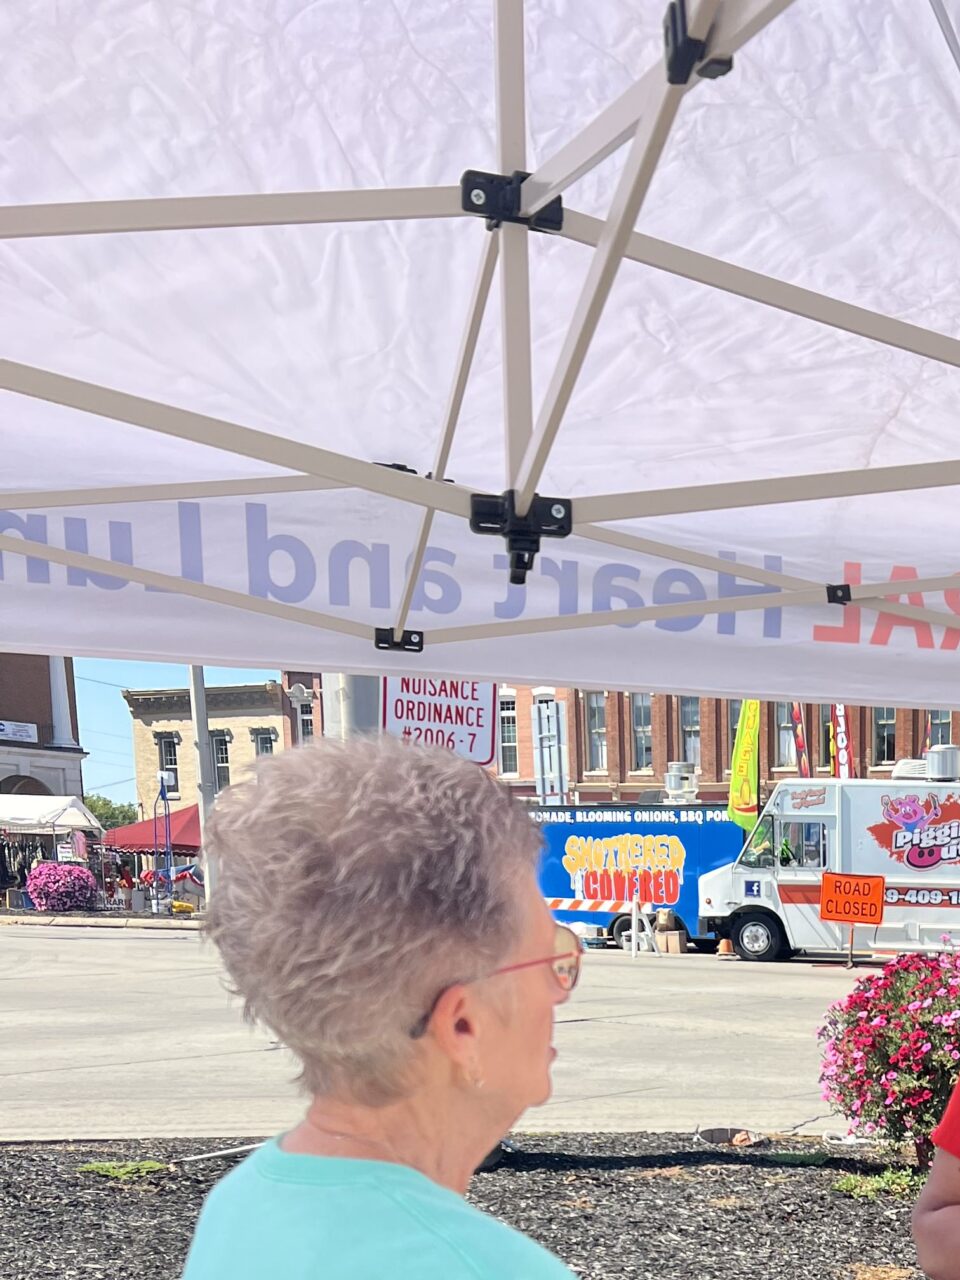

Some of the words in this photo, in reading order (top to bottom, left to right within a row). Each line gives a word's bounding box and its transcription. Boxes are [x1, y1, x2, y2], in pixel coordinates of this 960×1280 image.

[401, 677, 479, 701] NUISANCE
[394, 698, 485, 728] ORDINANCE
[402, 726, 477, 753] #2006-7
[575, 811, 632, 822] BLOOMING
[634, 811, 679, 824] ONIONS,
[680, 811, 704, 824] BBQ
[706, 811, 733, 822] POR
[562, 833, 687, 876] SMOTHERED
[583, 868, 681, 905] COVERED
[834, 880, 871, 897] ROAD
[826, 899, 878, 918] CLOSED
